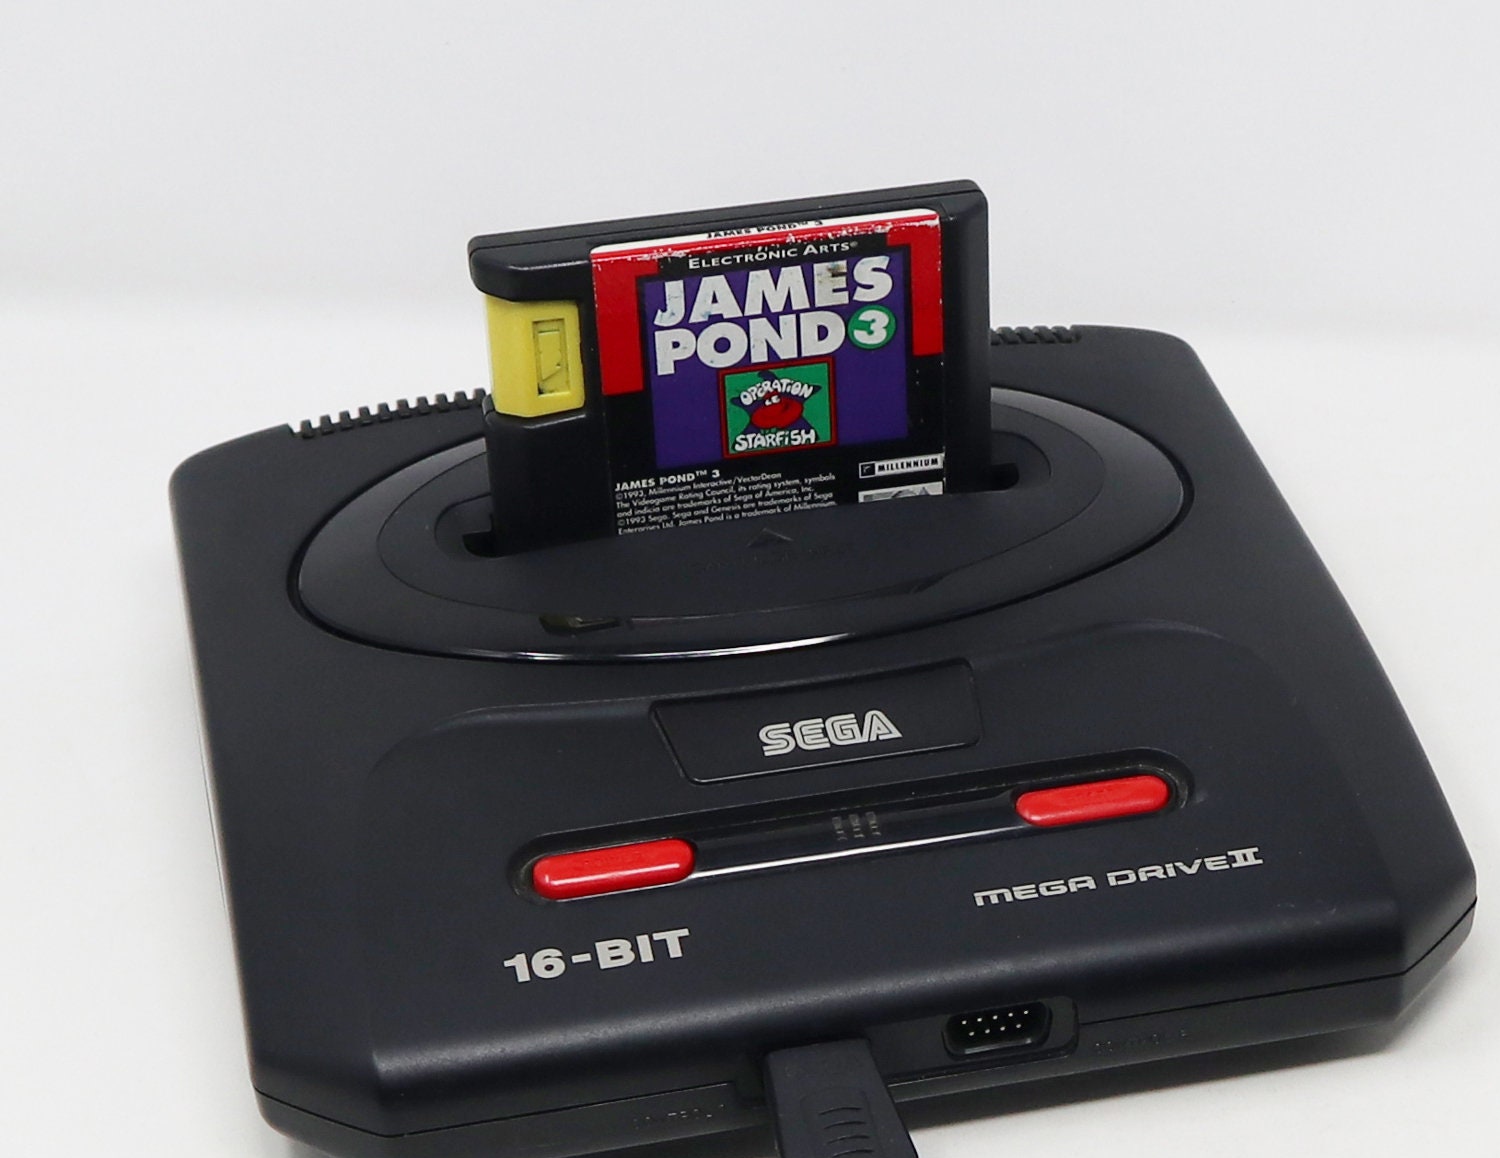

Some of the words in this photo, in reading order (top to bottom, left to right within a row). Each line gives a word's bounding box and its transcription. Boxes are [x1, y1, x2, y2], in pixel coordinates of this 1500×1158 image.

[688, 248, 798, 270] ELECTRONIC
[653, 254, 893, 327] JAMES
[654, 310, 846, 376] POND
[853, 309, 890, 345] 3
[615, 478, 656, 492] JAMES
[711, 469, 721, 478] 3
[877, 457, 939, 473] MILLENNIUM
[616, 501, 630, 509] The
[632, 496, 677, 506] Videogame
[679, 491, 704, 501] Rating
[748, 482, 772, 491] rating
[804, 473, 836, 485] symbols
[616, 509, 632, 518] and
[634, 506, 660, 515] indicia
[677, 498, 722, 509] trademarks
[734, 493, 753, 502] Sega
[801, 485, 815, 493] Inc.
[648, 485, 692, 495] Millennium
[672, 510, 692, 519] Sega
[693, 507, 709, 515] and
[711, 503, 741, 513] Genesis
[758, 495, 802, 506] trademarks
[813, 491, 834, 501] Sega
[678, 518, 702, 526] James
[704, 513, 724, 522] Pond
[742, 507, 782, 517] trademark
[758, 710, 902, 756] SEGA
[973, 875, 1098, 907] MEGA
[503, 927, 691, 984] 16-BIT
